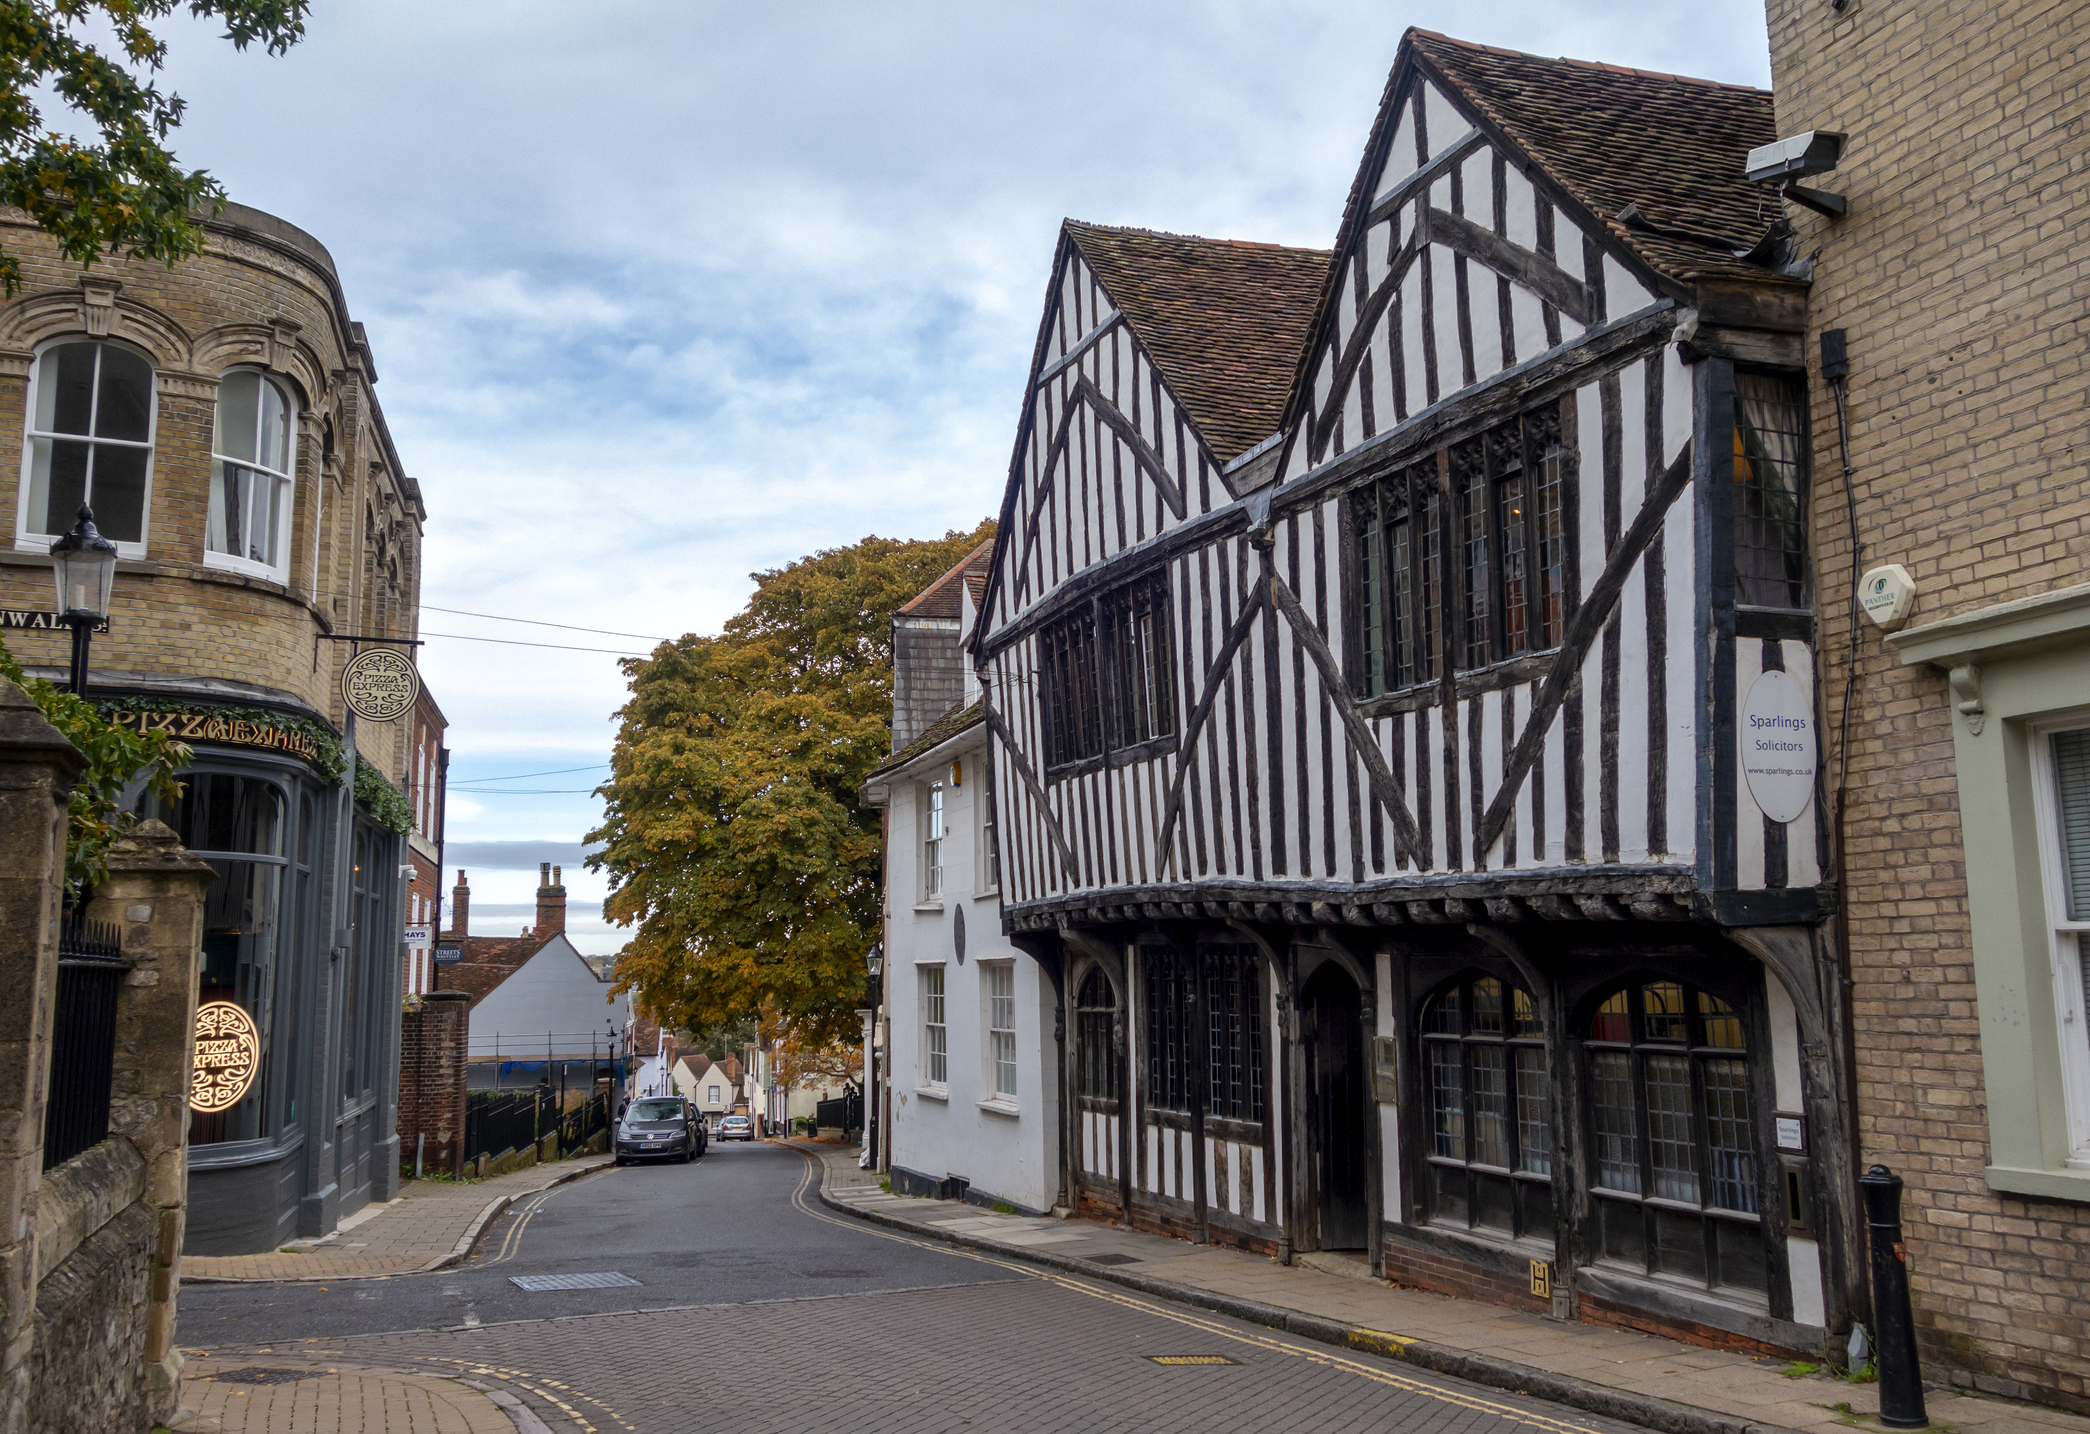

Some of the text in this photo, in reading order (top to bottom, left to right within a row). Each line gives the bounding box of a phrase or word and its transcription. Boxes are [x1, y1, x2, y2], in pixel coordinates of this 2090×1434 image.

[1864, 592, 1896, 606] PANTHER
[363, 674, 398, 683] PIZZA
[352, 682, 408, 692] EXPRESS
[1749, 714, 1806, 731] Sparlings
[1755, 740, 1804, 752] Solicitors
[1747, 767, 1813, 777] www.sparlings.co.uk
[195, 1039, 238, 1054] PIZZA
[193, 1051, 250, 1068] XPRESS
[1778, 1126, 1800, 1135] Sparlings
